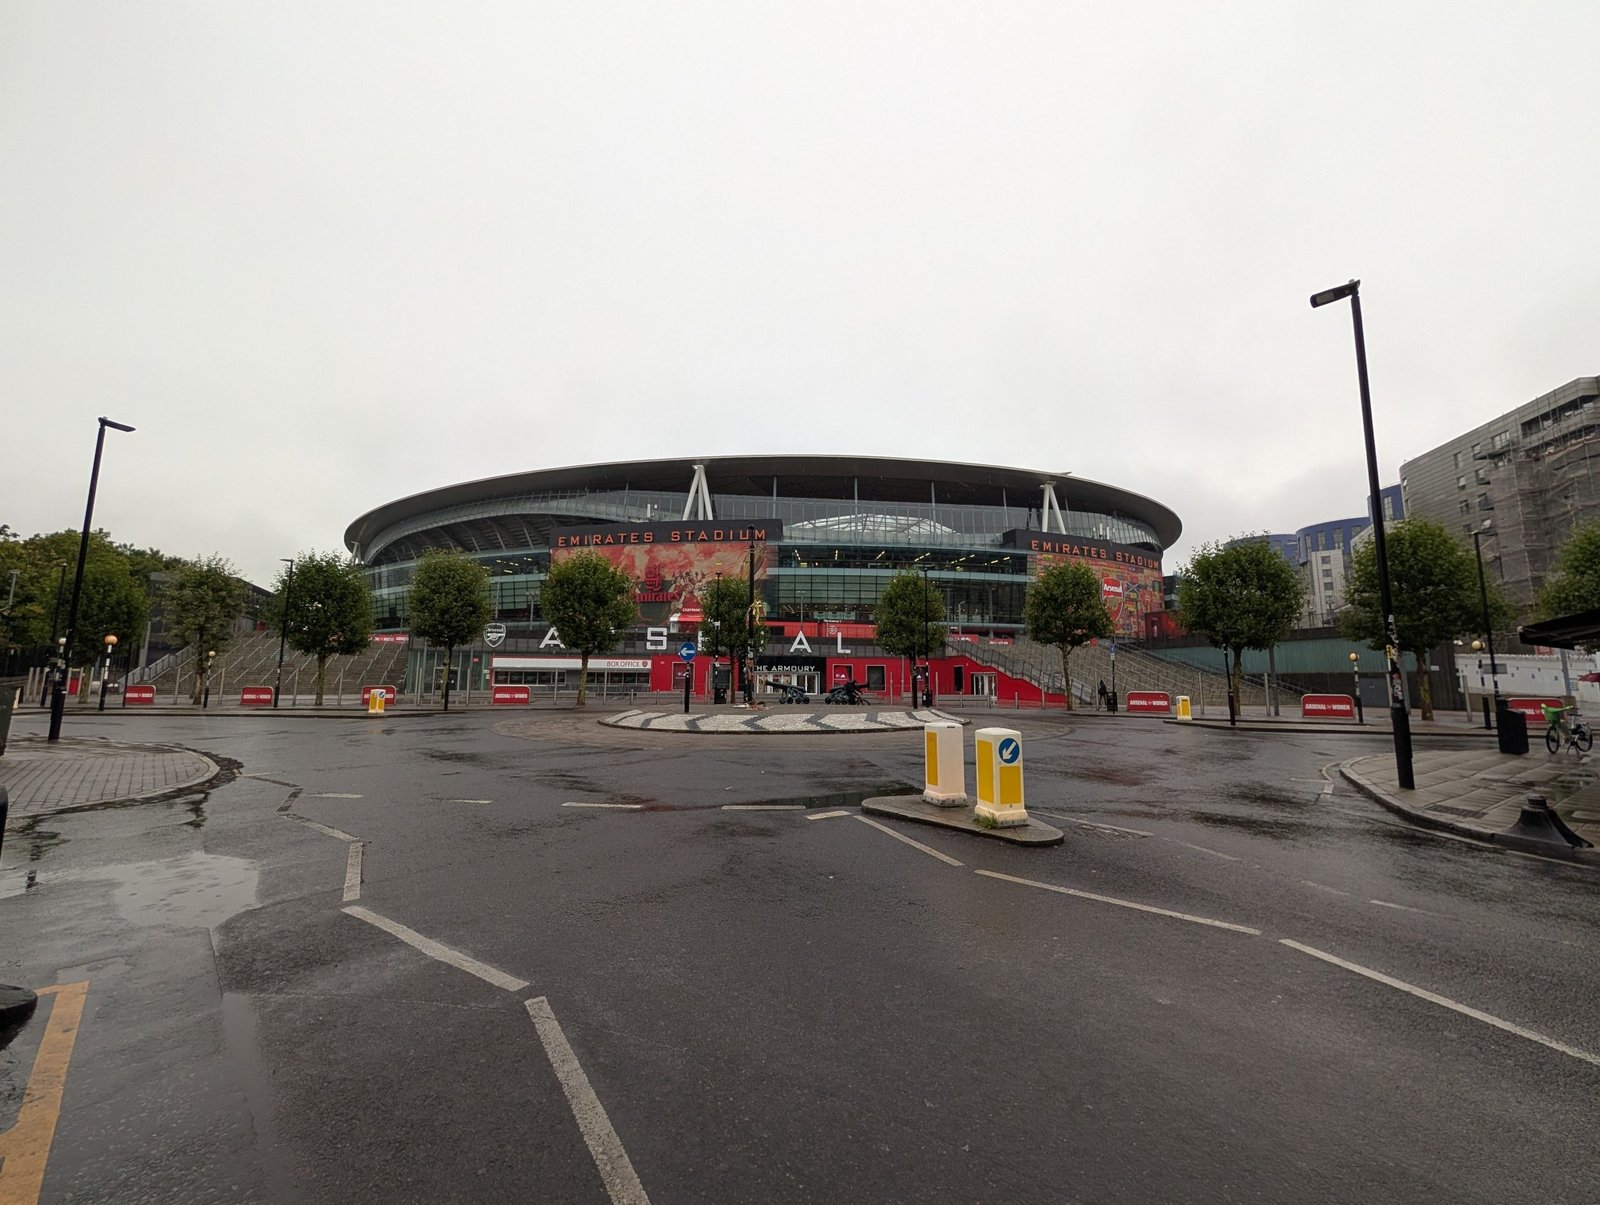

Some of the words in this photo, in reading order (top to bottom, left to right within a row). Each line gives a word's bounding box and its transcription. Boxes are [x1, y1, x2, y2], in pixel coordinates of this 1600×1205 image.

[558, 532, 653, 547] EMIRATES
[671, 529, 766, 542] STADIUM
[1031, 540, 1107, 559] EMIRATES
[1115, 552, 1159, 569] STADIUM
[1103, 584, 1123, 592] Arsenal
